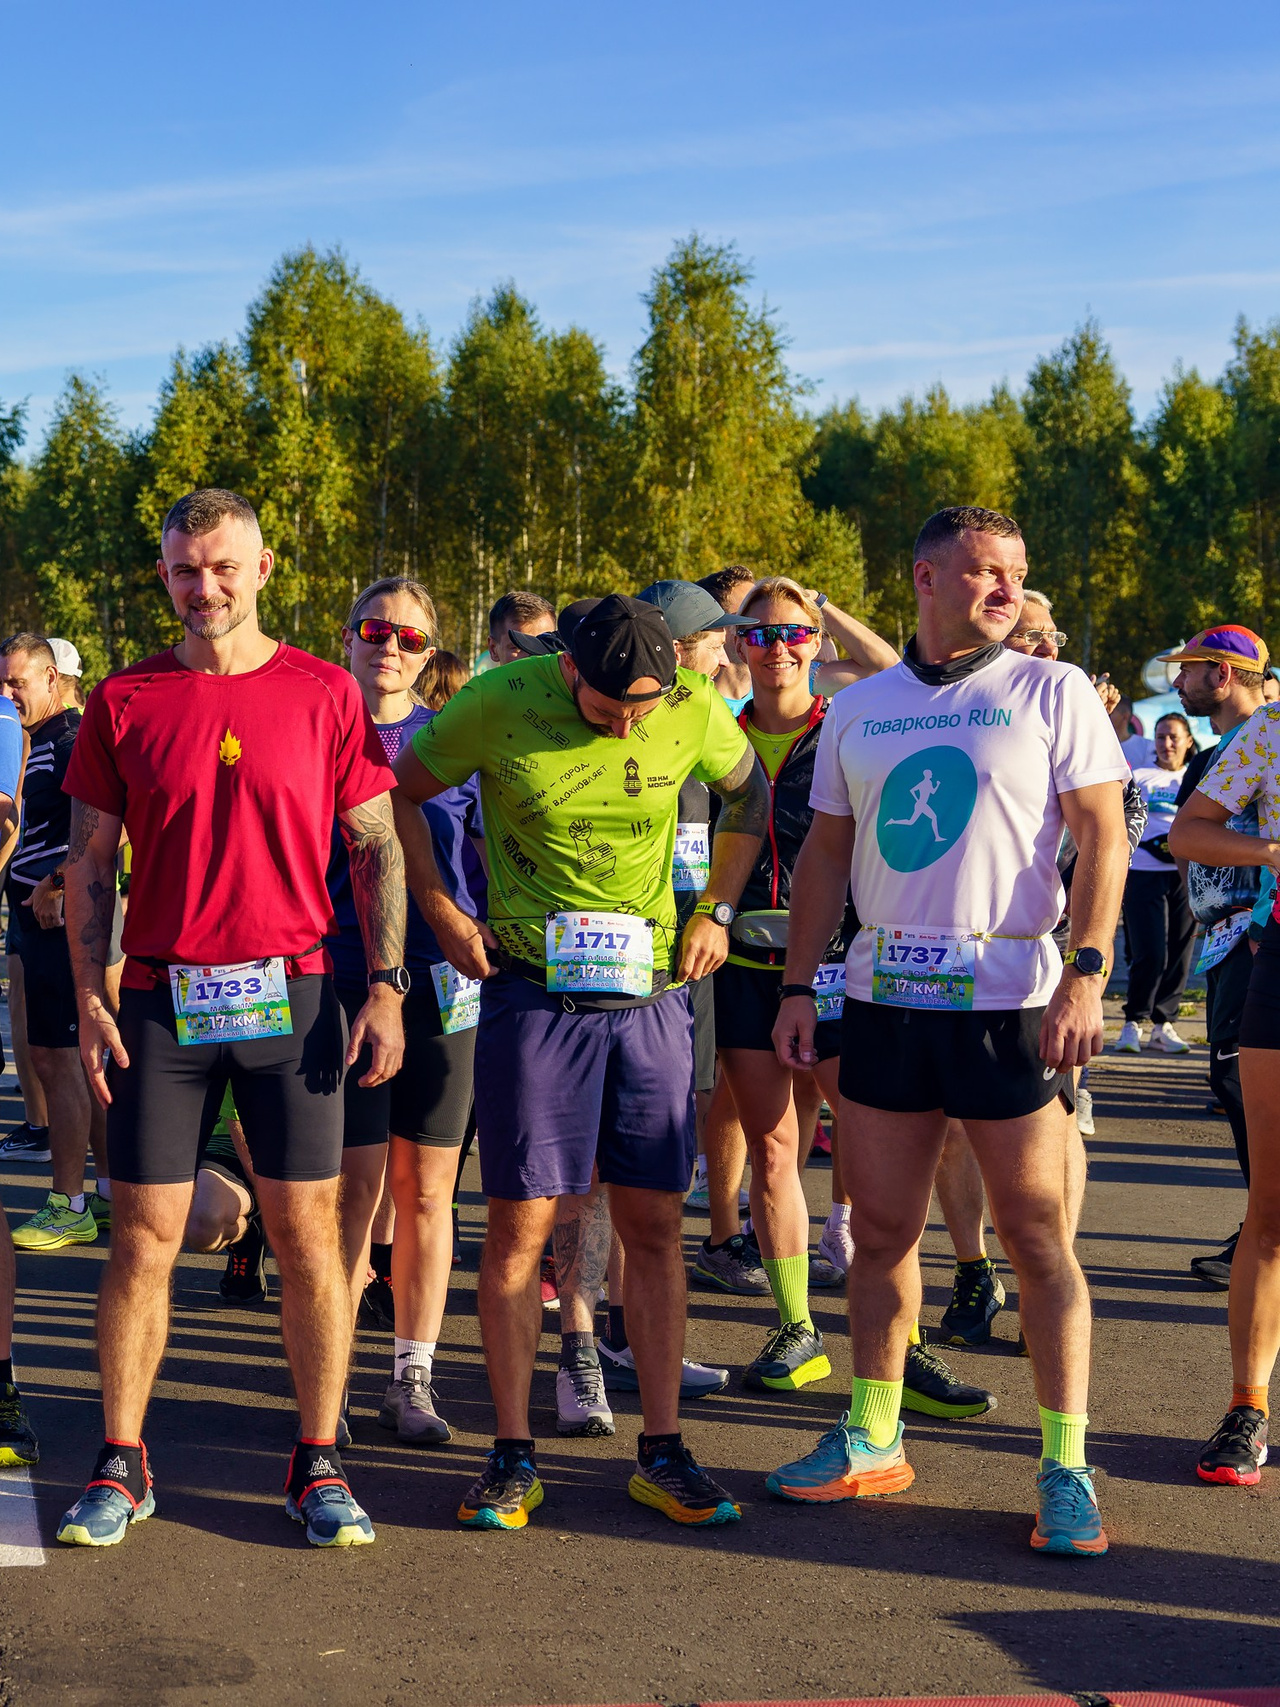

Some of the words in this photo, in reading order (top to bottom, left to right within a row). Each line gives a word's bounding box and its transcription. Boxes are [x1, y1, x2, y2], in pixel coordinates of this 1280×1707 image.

[862, 713, 962, 738] Товарково
[967, 708, 1012, 727] RUN
[552, 764, 608, 808] ВДОХНОВЛЯЕТ
[647, 780, 676, 788] МОСКВА
[515, 788, 548, 811] МОСКВА
[674, 840, 704, 855] 1741
[574, 931, 632, 950] 1717
[887, 944, 949, 965] 1737
[579, 964, 598, 979] 17
[603, 967, 627, 979] КМ
[902, 969, 927, 977] ЕГОР
[195, 977, 262, 1001] 1733
[452, 975, 482, 993] 17
[894, 978, 908, 993] 17
[913, 982, 938, 996] КМ
[210, 1002, 253, 1013] МАКСИМ
[465, 1002, 477, 1016] 17
[827, 996, 842, 1009] 17
[208, 1015, 227, 1030] 17
[231, 1013, 258, 1028] КМ
